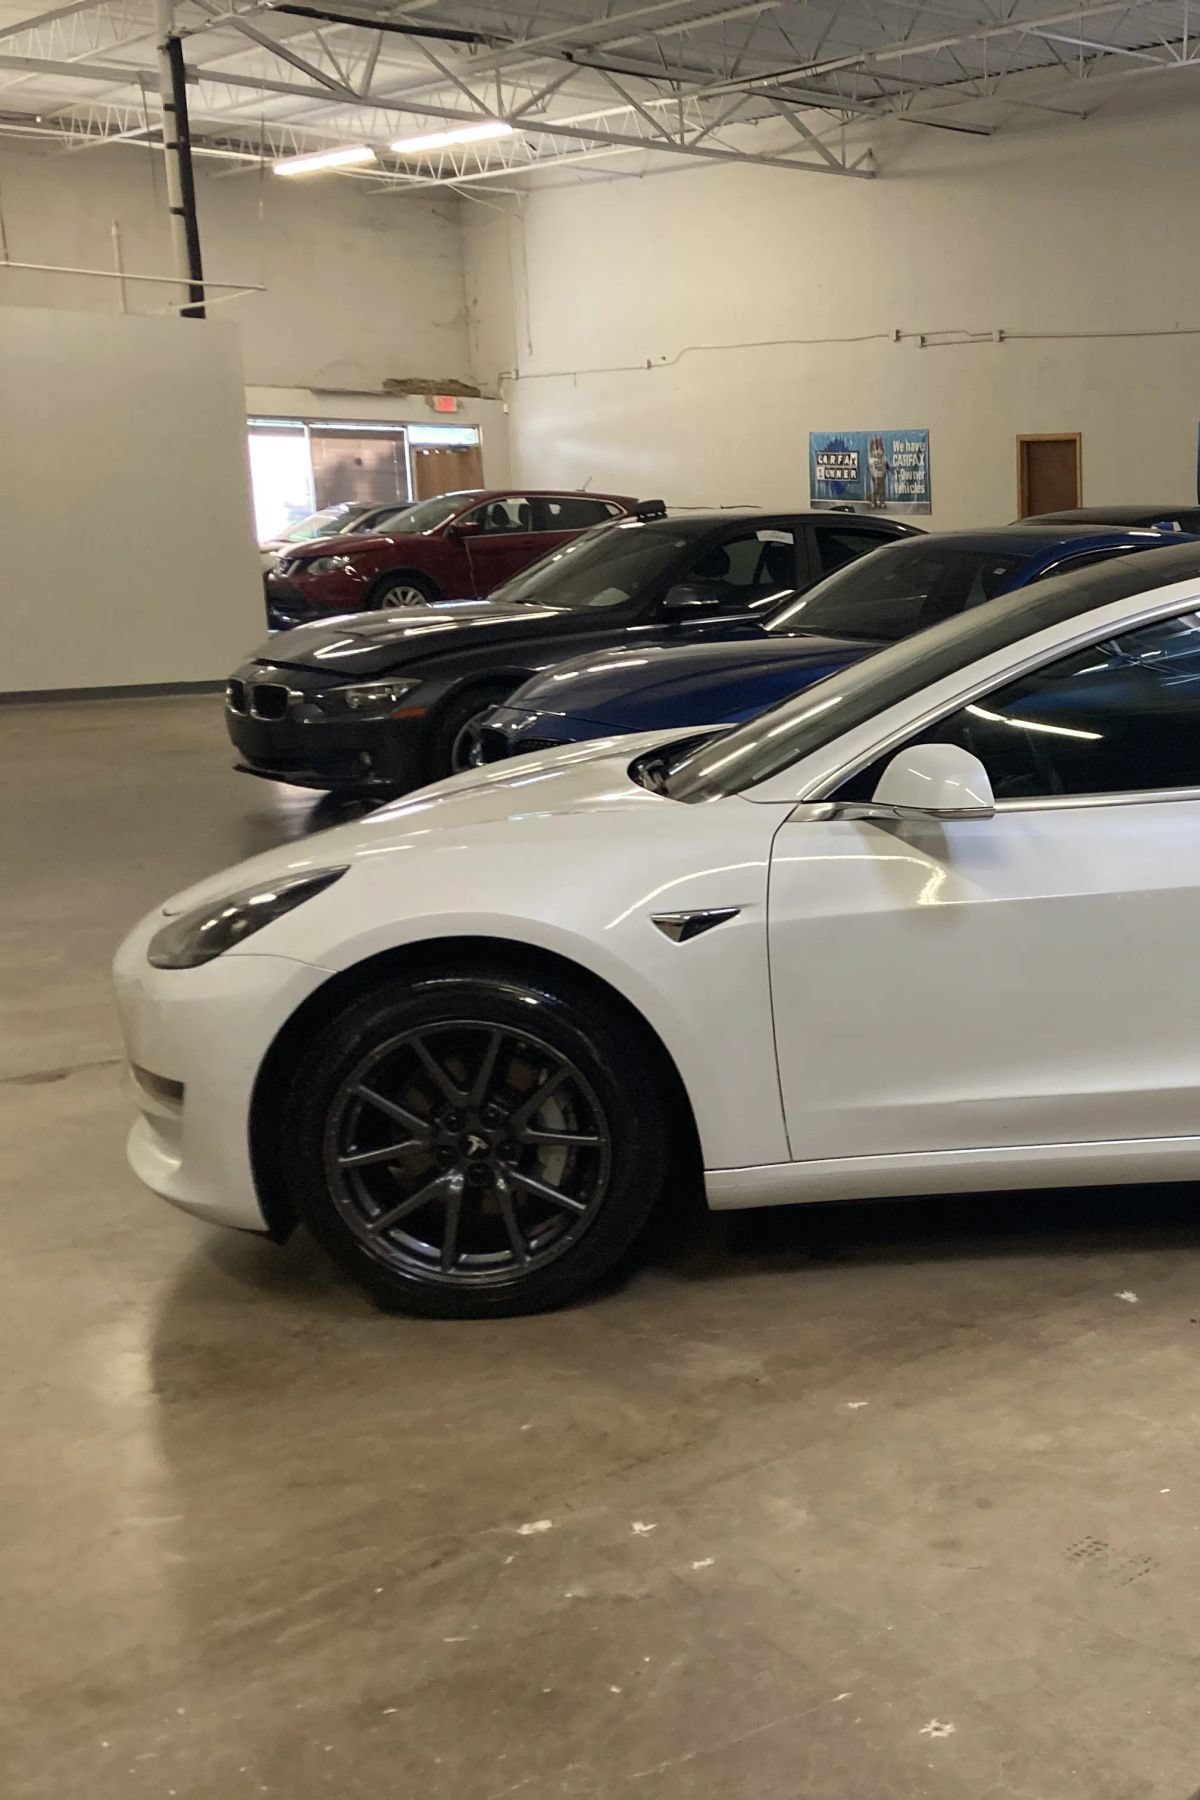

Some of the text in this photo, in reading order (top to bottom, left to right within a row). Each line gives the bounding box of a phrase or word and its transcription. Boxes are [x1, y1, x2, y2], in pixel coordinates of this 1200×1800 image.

[893, 440, 925, 452] We have
[817, 454, 856, 466] CARFAX
[893, 454, 925, 466] CARFAX
